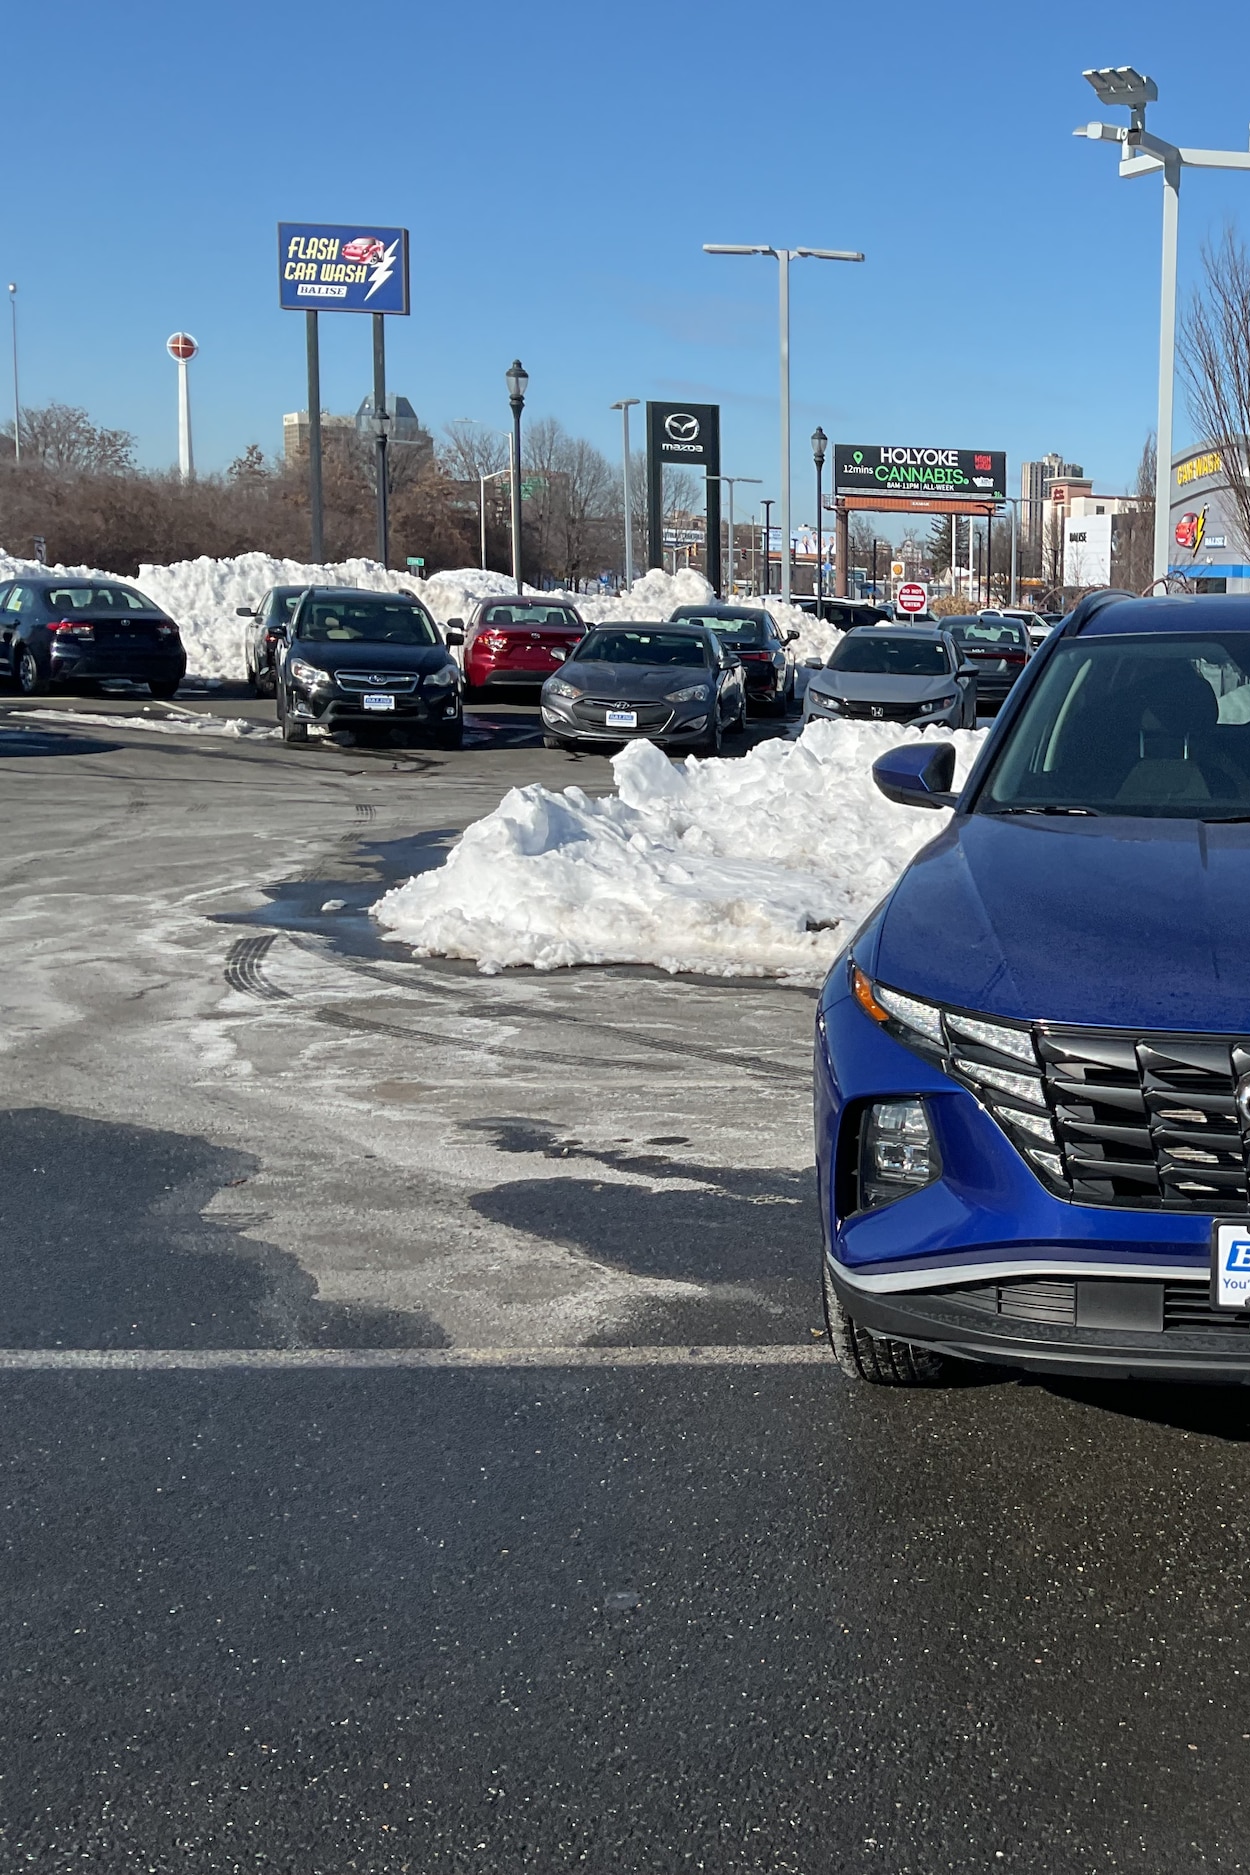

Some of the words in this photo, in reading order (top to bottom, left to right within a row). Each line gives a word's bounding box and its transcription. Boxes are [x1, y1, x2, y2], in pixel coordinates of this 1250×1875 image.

[288, 237, 339, 260] FLASH
[284, 262, 317, 280] CAR
[320, 264, 367, 283] WASH
[300, 286, 344, 295] BALISE
[662, 443, 703, 452] mazda
[880, 447, 958, 466] HOLYOKE
[843, 464, 873, 474] 12mins
[1177, 461, 1195, 486] CAR
[1195, 451, 1222, 477] WASH
